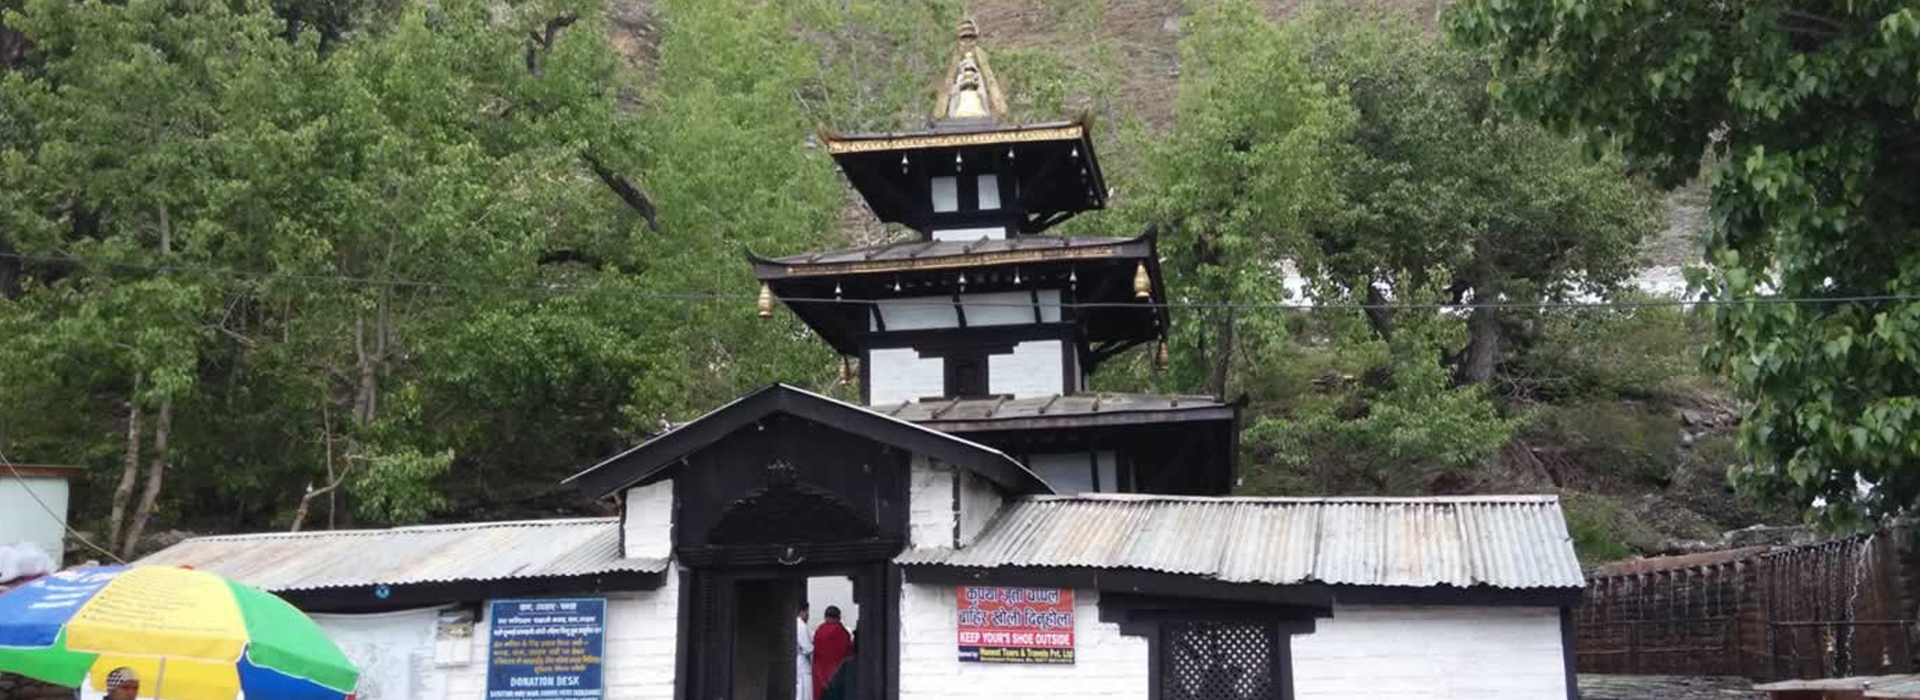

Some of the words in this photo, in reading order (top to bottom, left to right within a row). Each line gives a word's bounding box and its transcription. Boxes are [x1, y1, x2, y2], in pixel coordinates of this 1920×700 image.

[960, 631, 980, 643] KEEP
[1012, 632, 1034, 645] SHOE
[1036, 633, 1070, 646] OUTSIDE
[510, 676, 554, 687] DONATION
[556, 676, 580, 686] DESK
